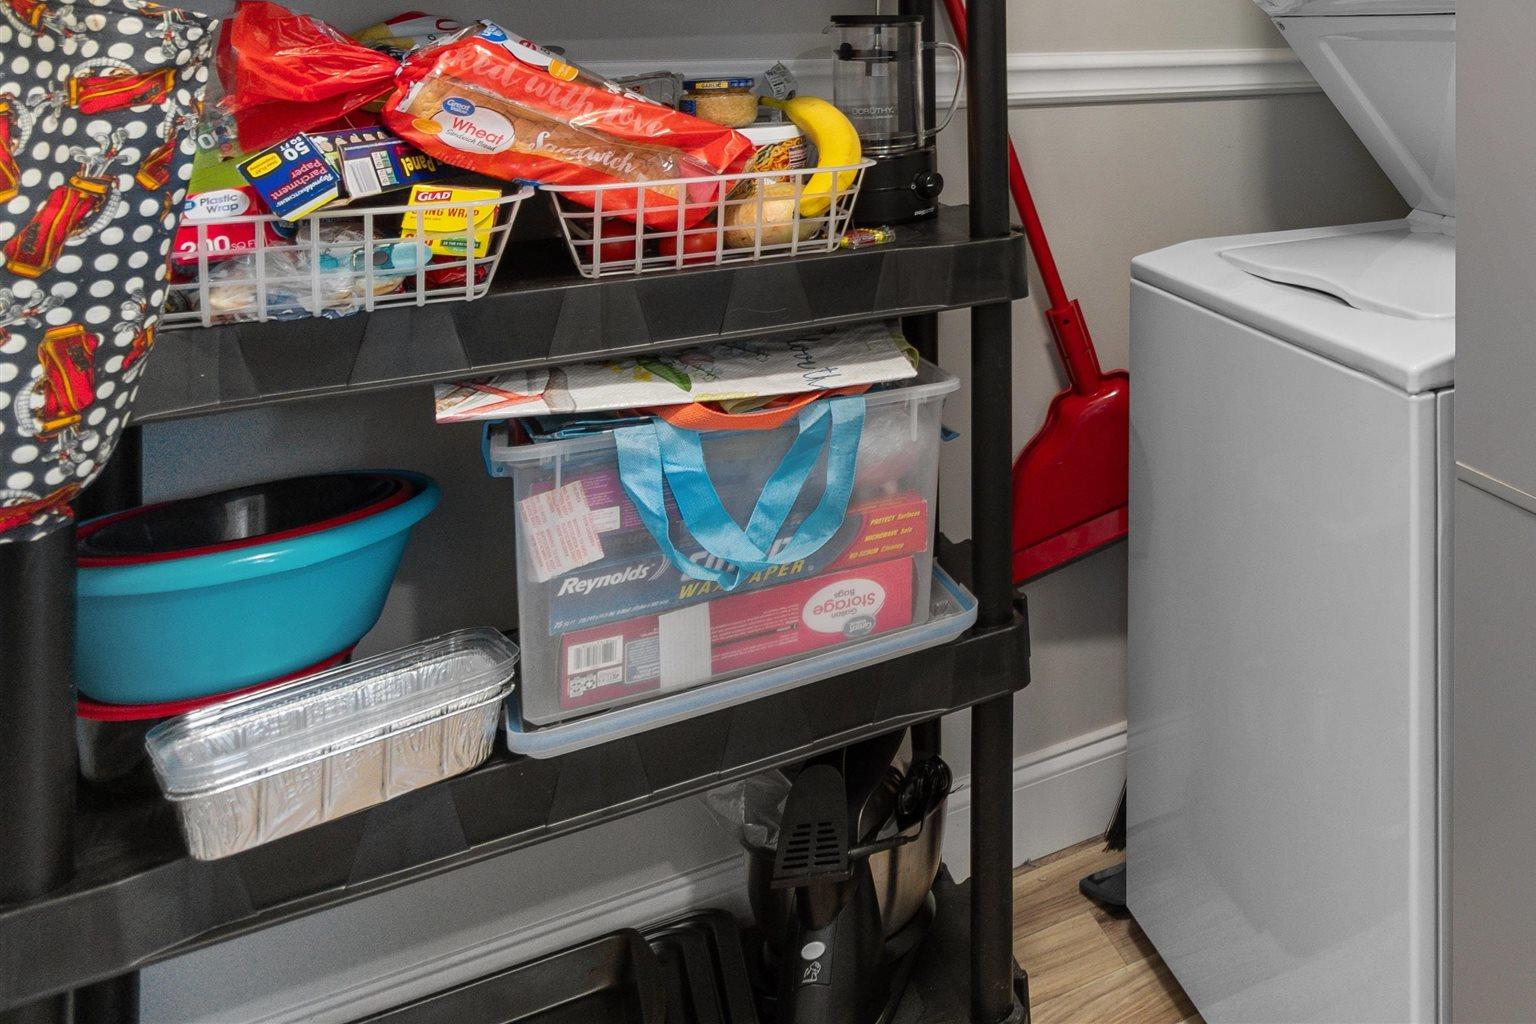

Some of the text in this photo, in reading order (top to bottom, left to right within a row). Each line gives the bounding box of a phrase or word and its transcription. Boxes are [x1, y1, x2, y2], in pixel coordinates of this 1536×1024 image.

[524, 73, 594, 116] with
[700, 81, 723, 89] GARLIC
[446, 98, 471, 111] Great
[450, 106, 469, 116] Value
[446, 128, 497, 153] Sandwich Bread
[452, 116, 504, 147] Wheat
[280, 142, 291, 152] FT
[283, 140, 311, 162] 50
[529, 131, 636, 174] Sandwich
[291, 158, 323, 179] Paper
[400, 156, 436, 177] Panel
[270, 166, 328, 201] Parchment
[200, 192, 239, 206] Plastic
[417, 191, 452, 201] GLAD
[206, 202, 239, 215] Wrap
[231, 242, 247, 251] SQ
[557, 566, 651, 597] Reynolds
[748, 559, 805, 584] APER
[834, 588, 856, 599] Bags
[812, 592, 876, 617] Storage
[831, 607, 858, 619] Gallon
